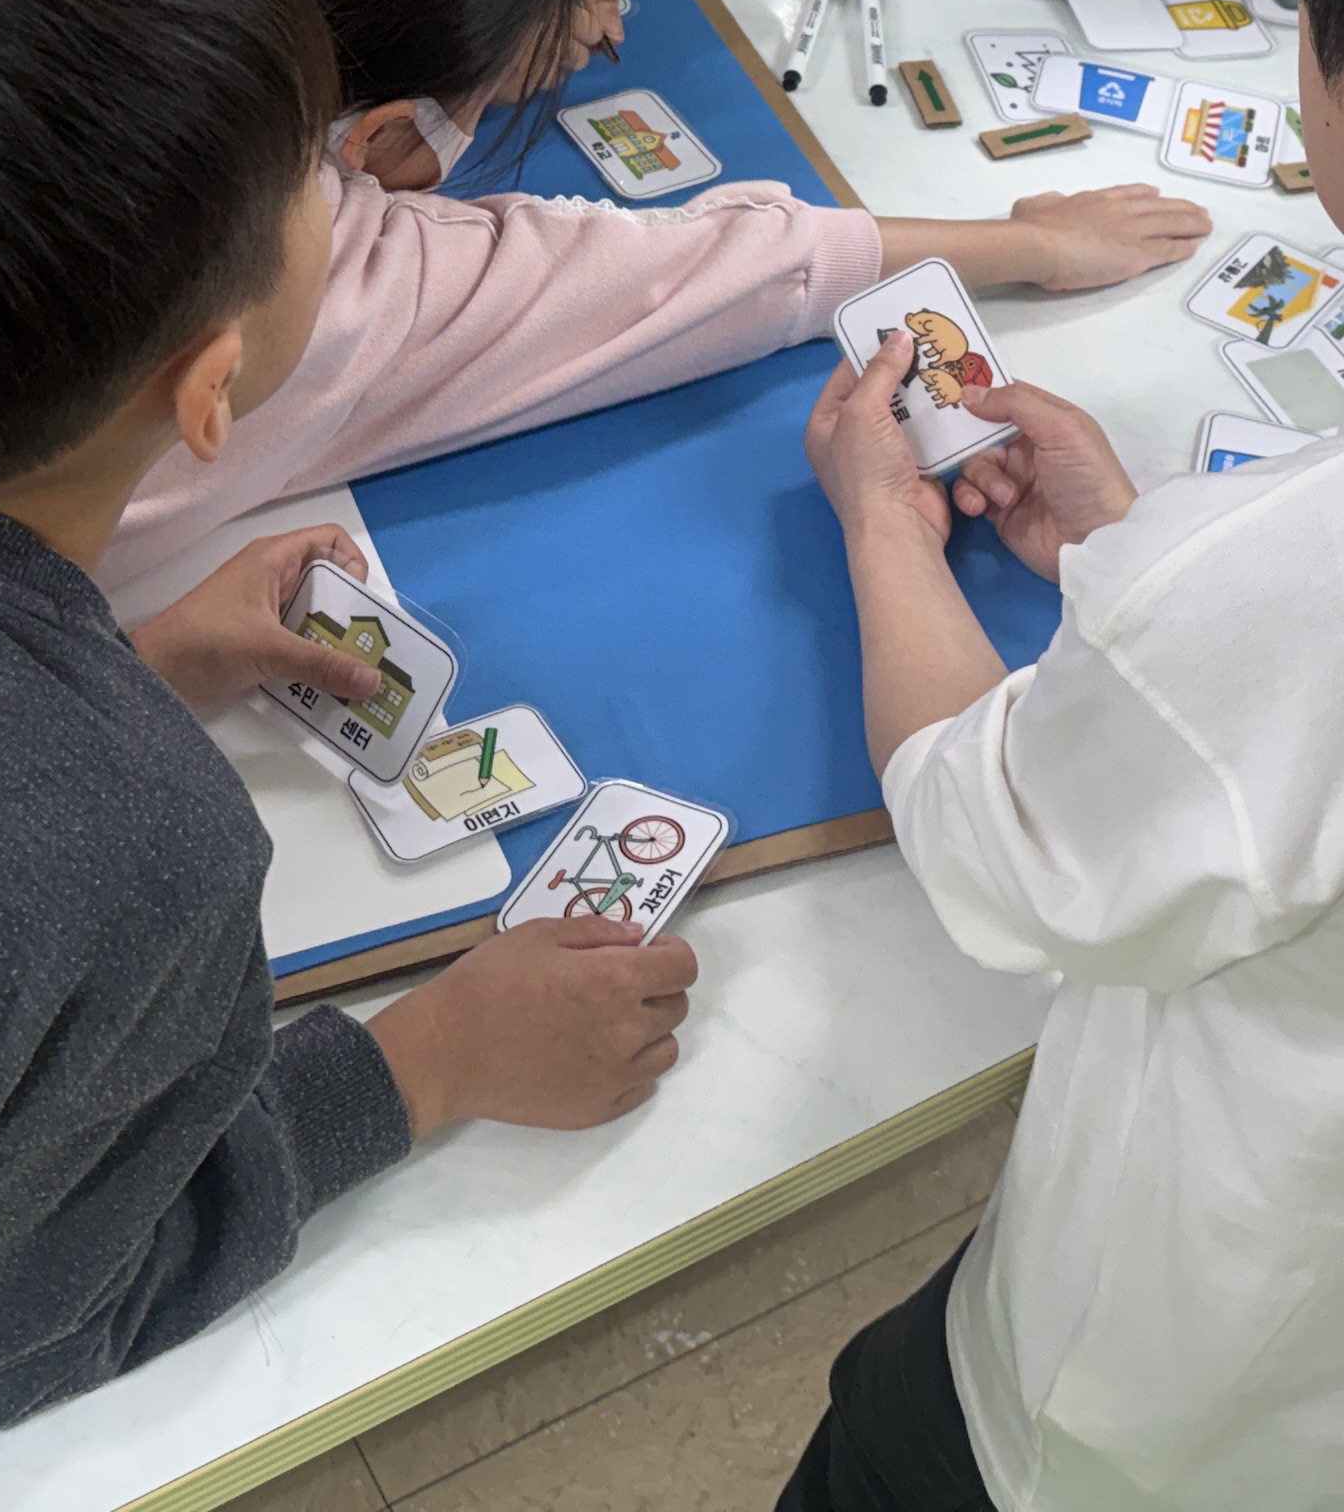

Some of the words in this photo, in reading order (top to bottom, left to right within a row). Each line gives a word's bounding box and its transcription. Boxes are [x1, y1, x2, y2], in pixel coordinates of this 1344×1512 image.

[339, 717, 373, 751] 센터
[463, 800, 521, 832] 이면지
[639, 868, 684, 916] 자전거
